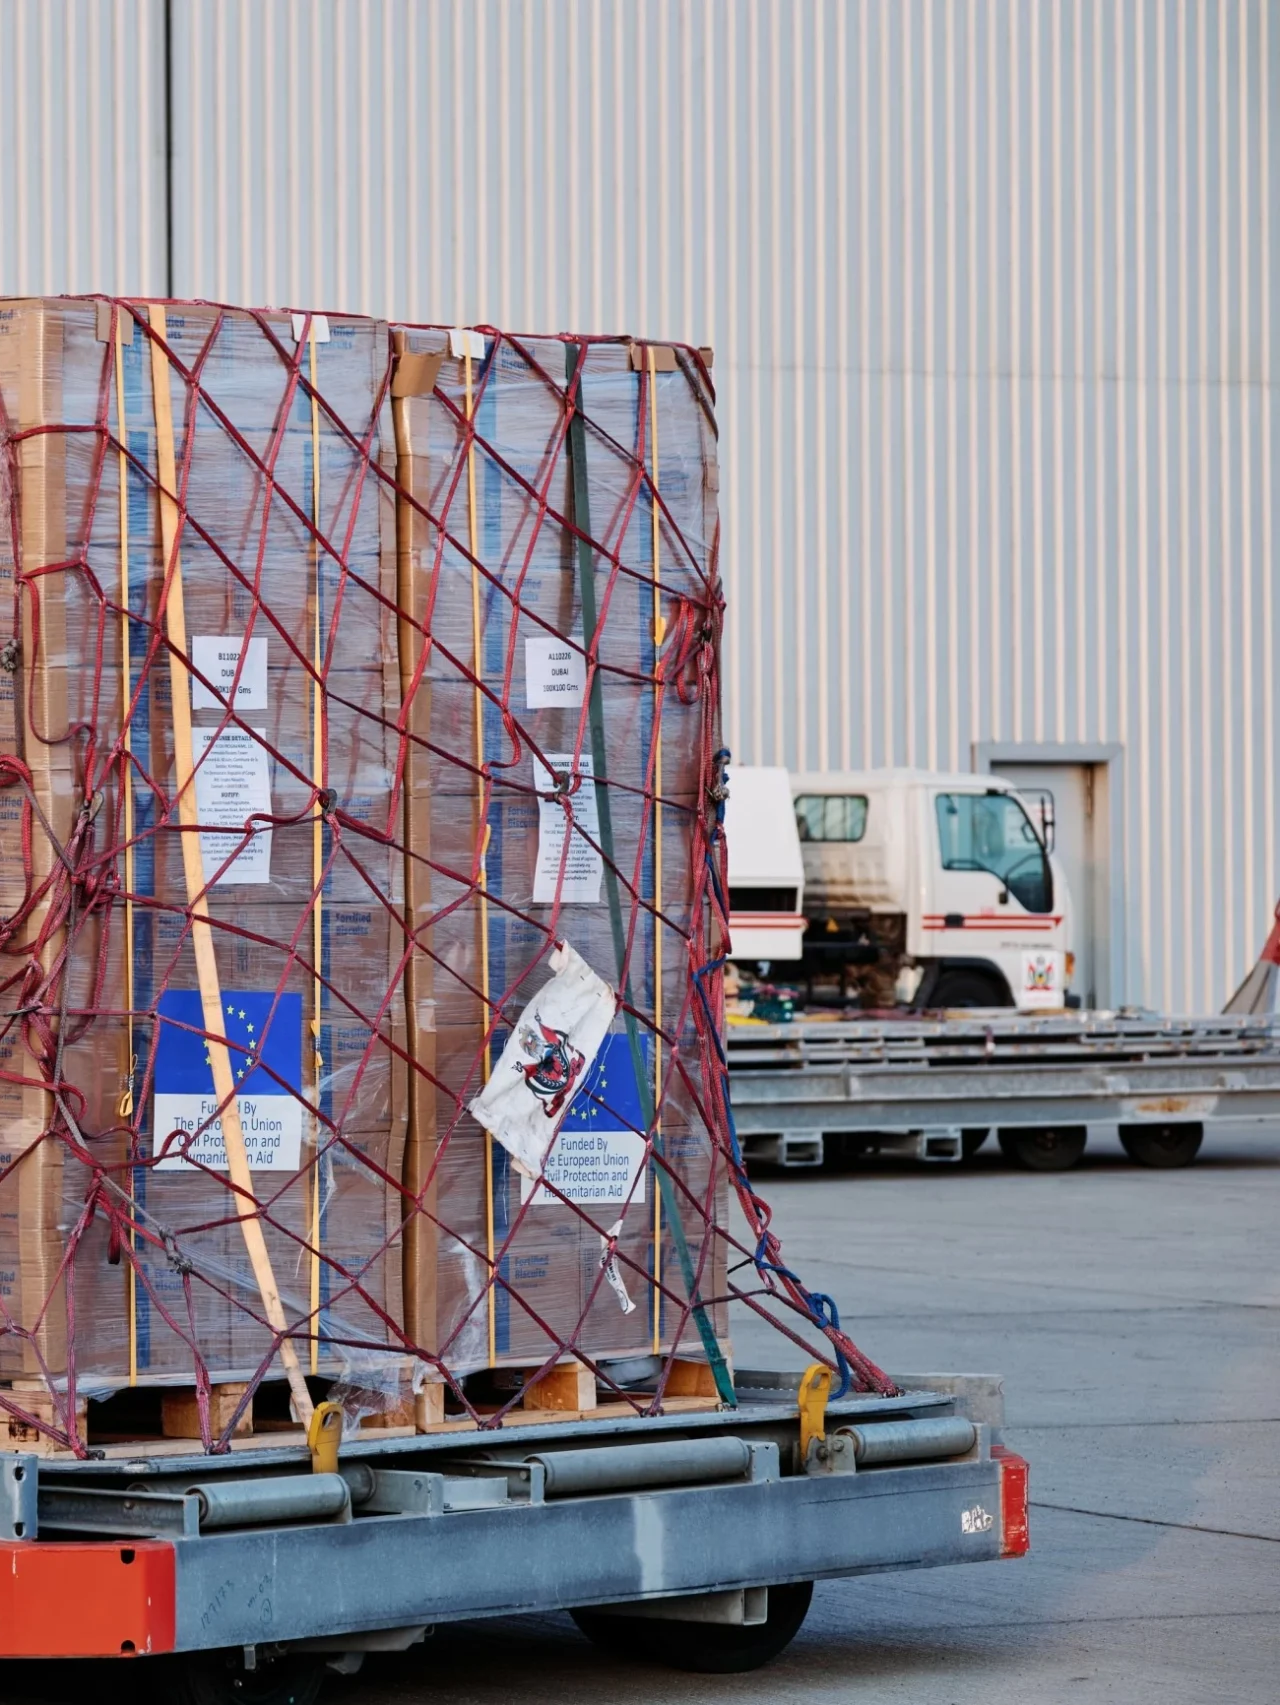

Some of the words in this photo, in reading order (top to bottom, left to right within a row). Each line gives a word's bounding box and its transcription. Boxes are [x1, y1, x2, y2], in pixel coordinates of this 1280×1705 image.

[548, 652, 572, 660] A110226
[551, 668, 569, 676] DUBAI
[238, 686, 251, 694] Gms
[201, 1101, 240, 1114] Fud
[244, 1101, 257, 1116] By
[174, 1117, 194, 1131] The
[197, 1117, 247, 1131] Euron
[251, 1117, 282, 1131] Union
[178, 1135, 200, 1147] Cil
[203, 1134, 257, 1148] Proton
[261, 1135, 280, 1148] and
[560, 1137, 595, 1151] Funded
[597, 1138, 609, 1154] By
[180, 1151, 253, 1164] umanitn
[256, 1151, 273, 1164] Aid
[557, 1154, 600, 1170] European
[602, 1154, 629, 1166] Union
[542, 1168, 561, 1182] Civil
[563, 1168, 609, 1182] Protection
[611, 1168, 628, 1182] and
[607, 1184, 623, 1197] Aid
